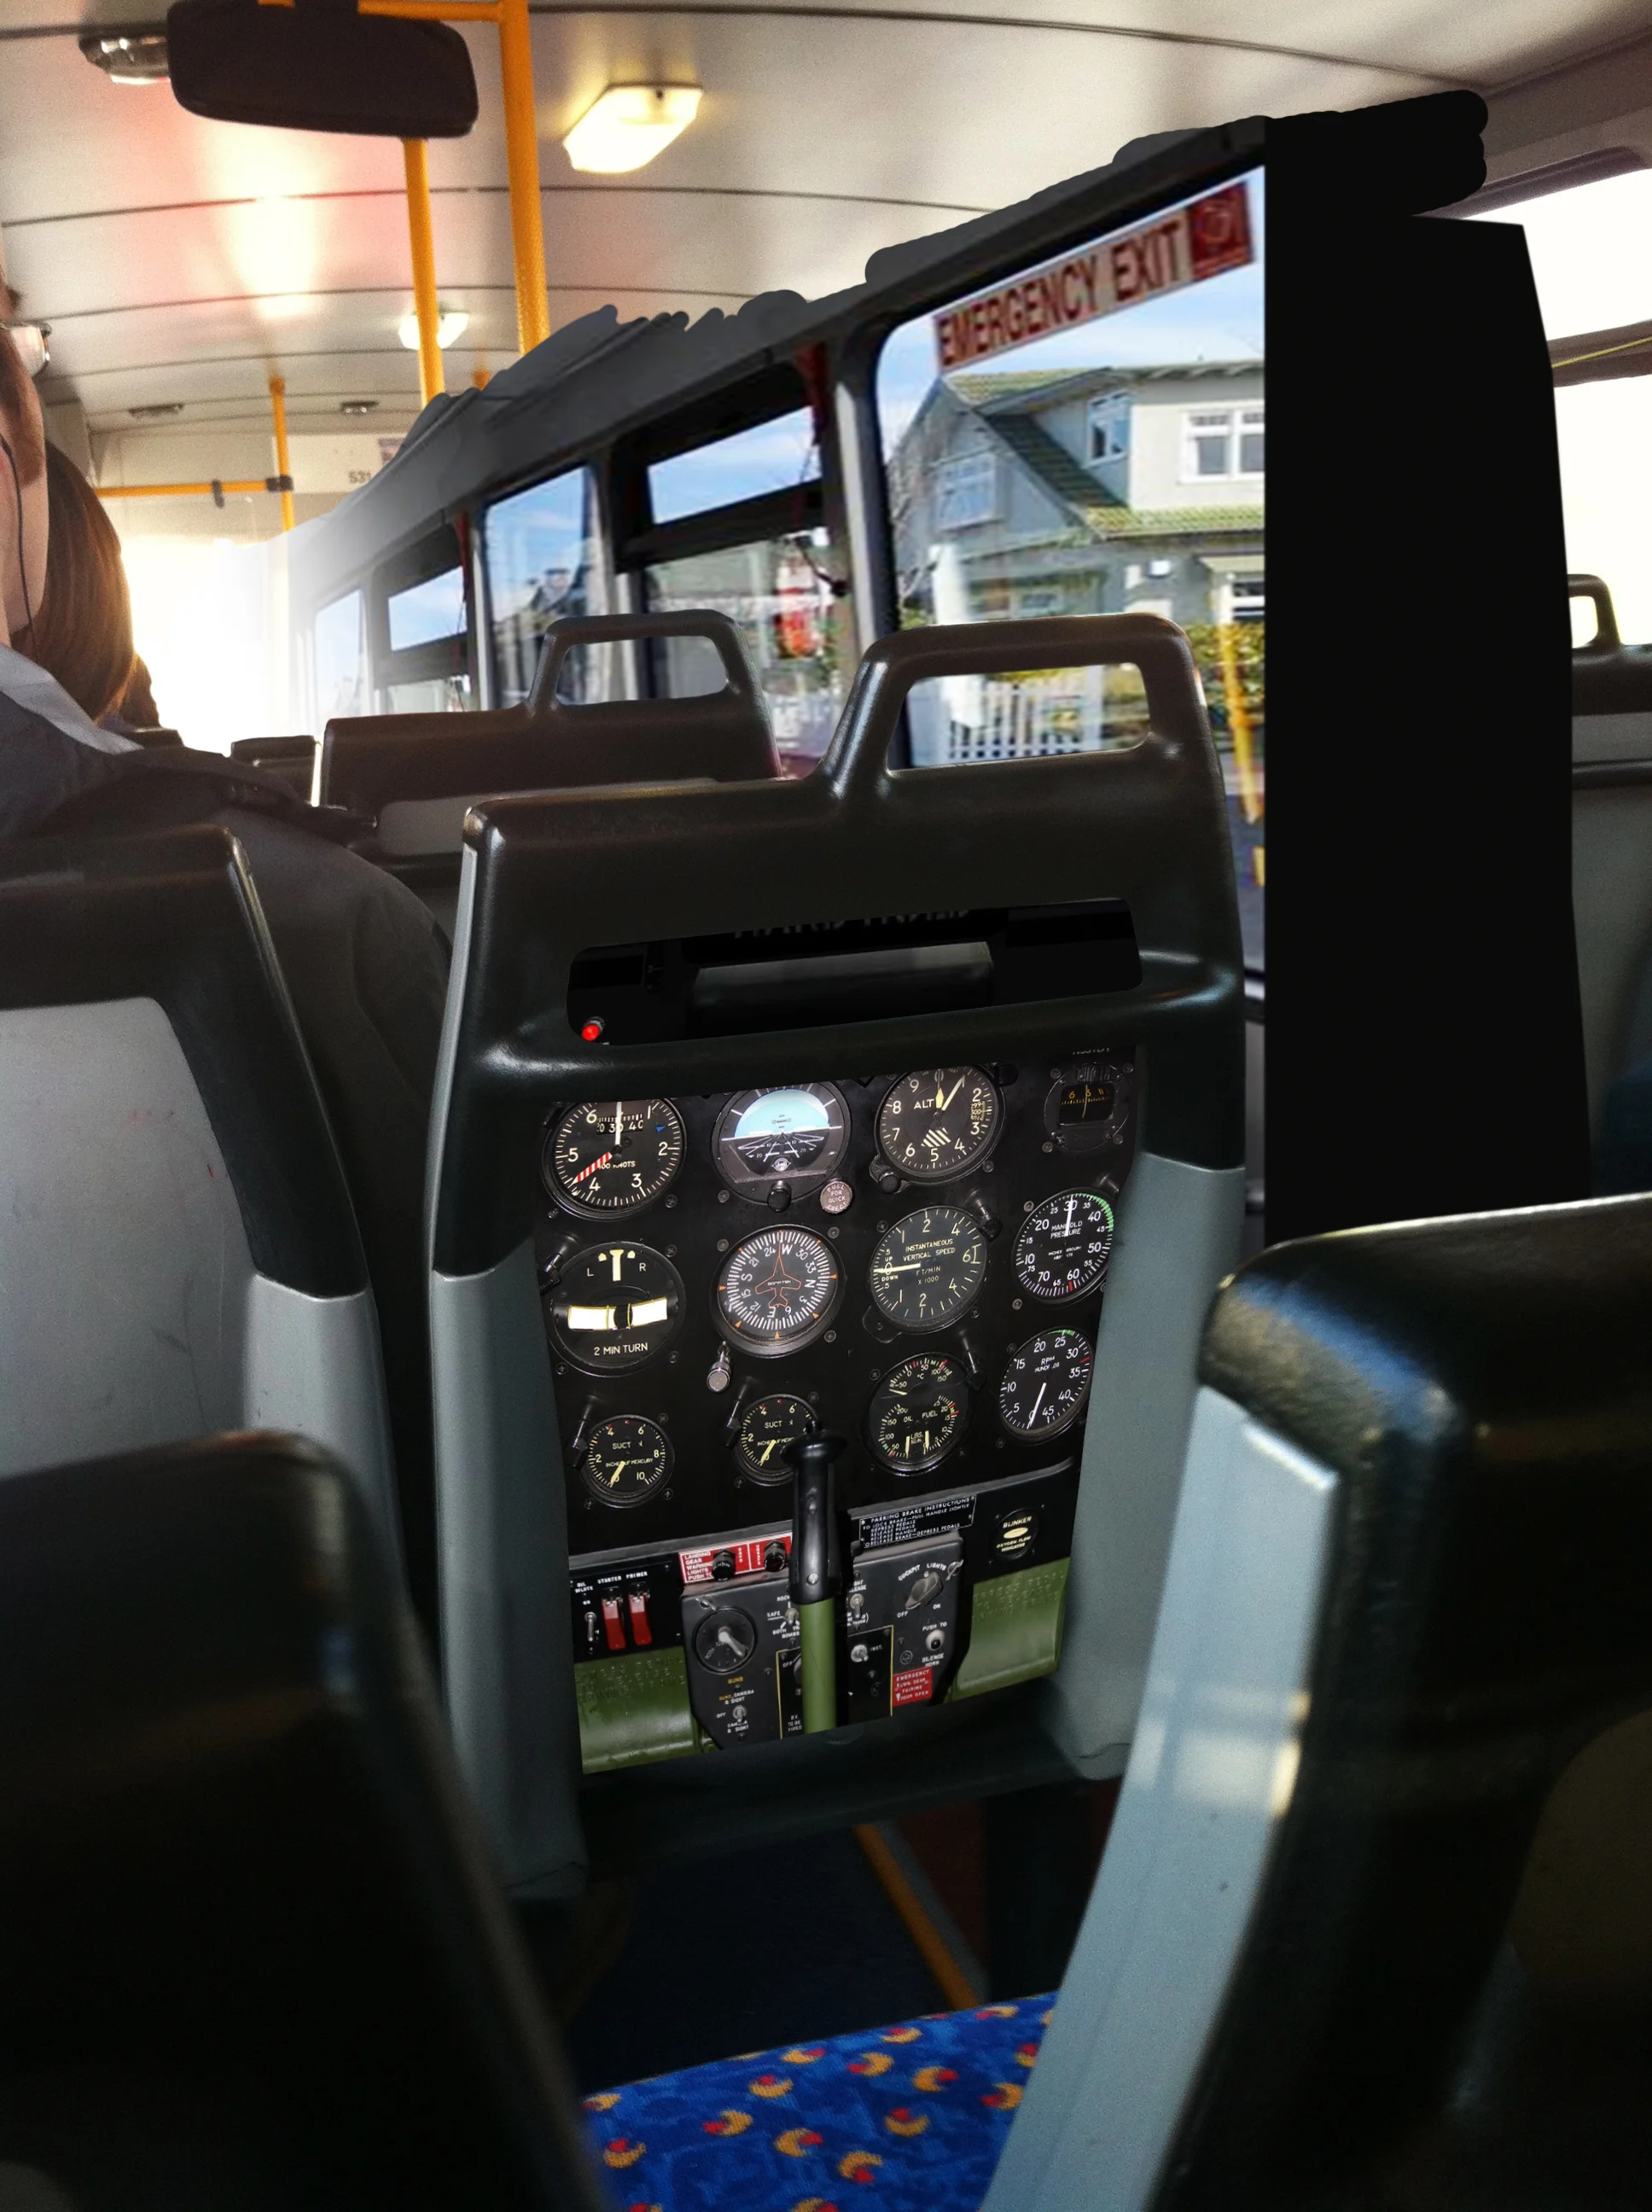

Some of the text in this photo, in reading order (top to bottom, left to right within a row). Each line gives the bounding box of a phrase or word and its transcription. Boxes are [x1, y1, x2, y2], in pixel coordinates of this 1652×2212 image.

[939, 219, 1182, 366] EMERGENCY EXIT
[910, 1079, 919, 1092] 9
[972, 1088, 981, 1102] 2
[892, 1100, 901, 1115] 8
[914, 1099, 934, 1109] ALT
[586, 1109, 597, 1123] 6
[970, 1121, 980, 1135] 3
[893, 1127, 900, 1141] 7
[659, 1142, 668, 1155] 2
[955, 1138, 965, 1150] 4
[567, 1148, 579, 1162] 5
[905, 1143, 916, 1157] 6
[931, 1148, 939, 1161] 5
[589, 1177, 601, 1191] 4
[631, 1173, 642, 1187] 3
[827, 1184, 845, 1193] PULL
[826, 1202, 847, 1212] ERECT
[1063, 1200, 1078, 1211] 30
[1088, 1211, 1101, 1222] 40
[922, 1219, 931, 1232] 2
[951, 1223, 960, 1236] 4
[1034, 1219, 1049, 1231] 20
[1050, 1228, 1081, 1239] PRESURE
[782, 1244, 793, 1254] W
[905, 1238, 953, 1252] INSTANTANEOUS
[1087, 1242, 1102, 1254] 50
[764, 1246, 777, 1257] 24
[795, 1249, 809, 1260] 30
[903, 1248, 956, 1261] VERTICAL SPEED
[963, 1249, 970, 1263] 6
[749, 1257, 759, 1267] 21
[1025, 1253, 1035, 1265] 10
[587, 1267, 594, 1277] L
[639, 1262, 646, 1272] R
[806, 1261, 817, 1273] 33
[741, 1272, 753, 1282] S
[1038, 1271, 1050, 1282] 70
[1067, 1268, 1080, 1280] 60
[804, 1279, 817, 1288] N
[949, 1278, 957, 1289] 4
[741, 1289, 751, 1298] 15
[919, 1293, 927, 1307] 2
[750, 1301, 761, 1312] 12
[767, 1306, 776, 1318] E
[785, 1306, 792, 1314] 6
[1033, 1341, 1046, 1353] 20
[1054, 1336, 1066, 1348] 25
[594, 1342, 649, 1355] 2 MIN TURN
[1066, 1348, 1079, 1359] 30
[1016, 1359, 1026, 1369] 15
[1040, 1355, 1056, 1365] RPM
[1068, 1367, 1080, 1378] 35
[1007, 1381, 1016, 1393] 10
[1058, 1389, 1071, 1400] 40
[789, 1405, 795, 1413] 6
[1013, 1402, 1020, 1413] 5
[1042, 1405, 1054, 1416] 45
[765, 1420, 782, 1429] SUCT
[638, 1426, 644, 1435] 6
[747, 1433, 754, 1442] 2
[612, 1441, 631, 1450] SUCT
[596, 1454, 602, 1463] 2
[654, 1449, 660, 1458] 8
[636, 1471, 645, 1481] 10
[871, 1498, 970, 1523] PARKING BRAKE INSTRUCTIONS
[926, 1508, 947, 1516] HANDLE
[1003, 1516, 1032, 1528] BLINKER
[686, 1562, 713, 1570] WARNING
[899, 1563, 947, 1580] COCKPIT LIGHTS
[597, 1575, 622, 1584] STARTER
[625, 1571, 648, 1580] PRIMER
[922, 1623, 937, 1632] PUSH
[922, 1653, 944, 1663] SILENCE
[896, 1669, 930, 1682] EMERGENCY
[734, 1689, 755, 1698] CAMERA
